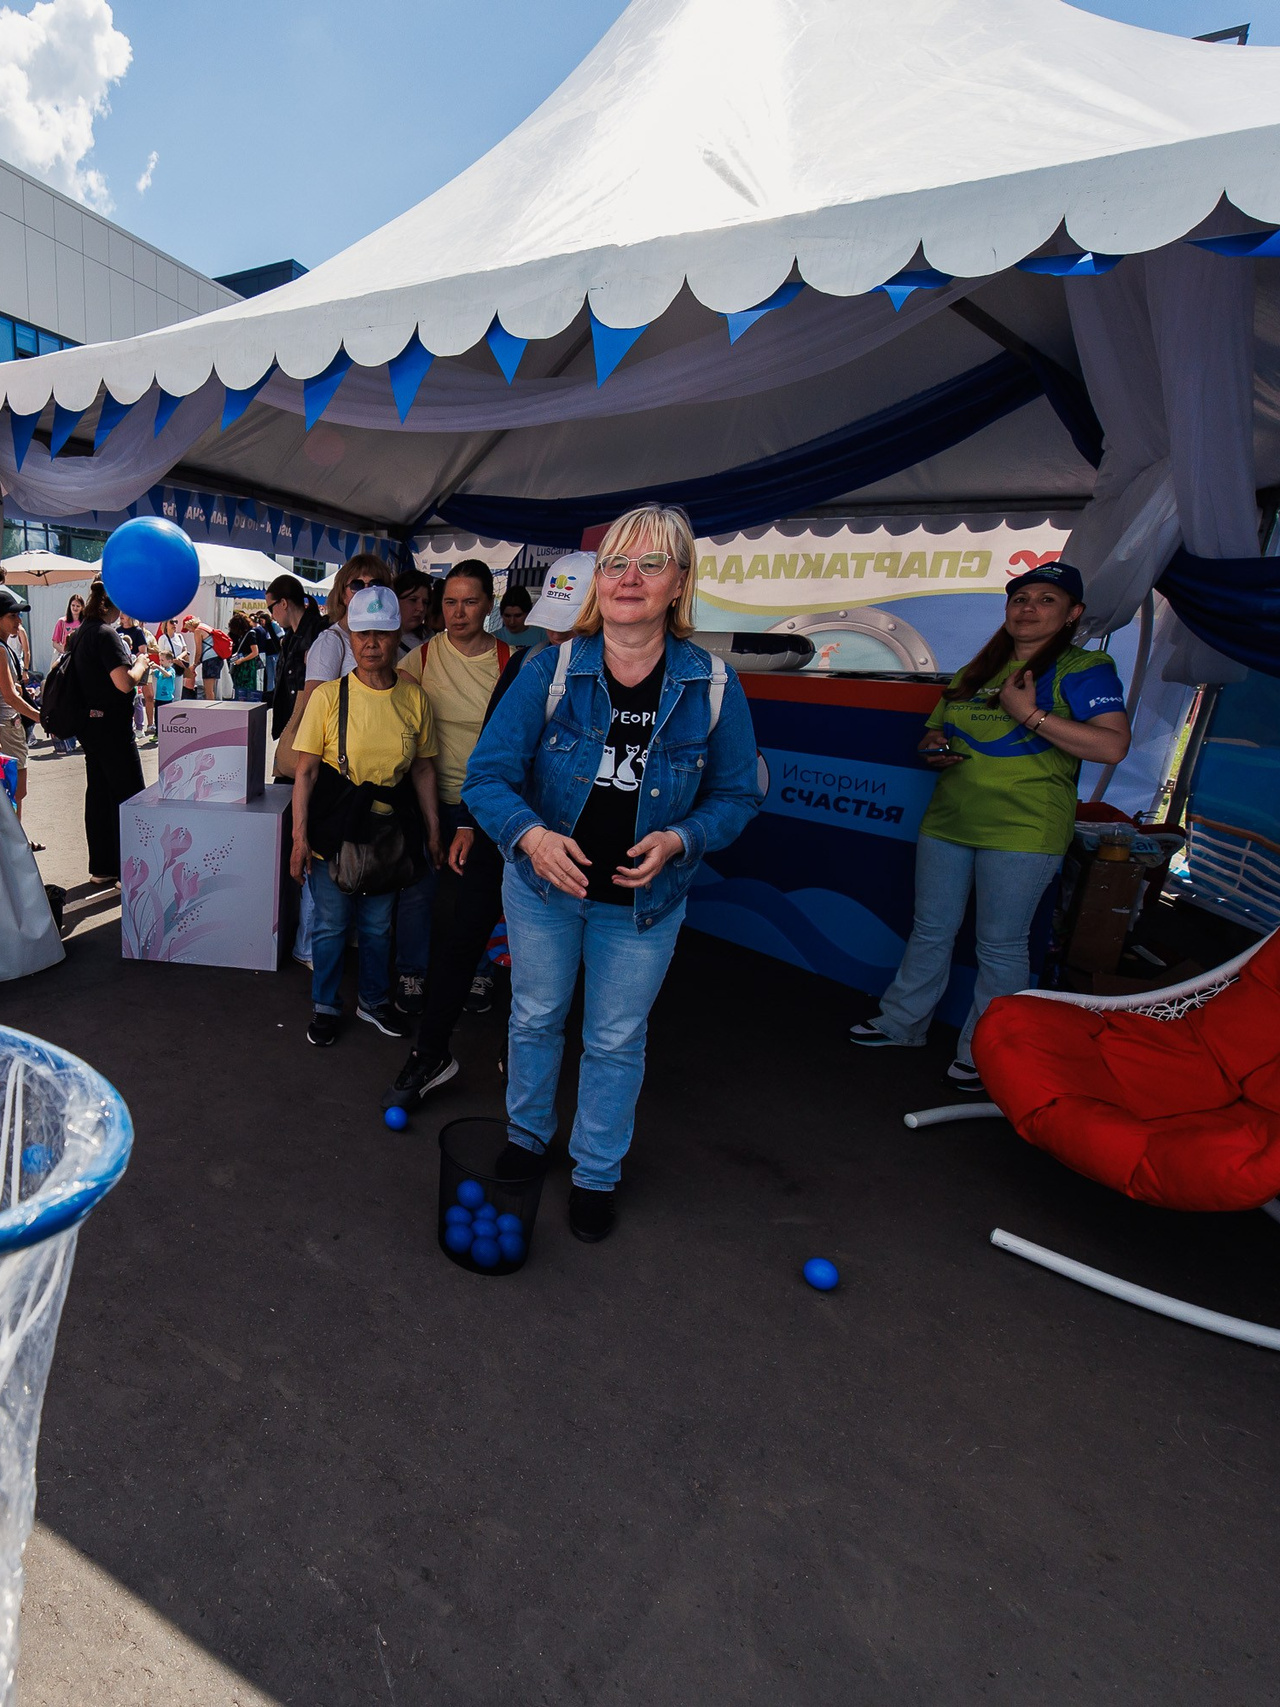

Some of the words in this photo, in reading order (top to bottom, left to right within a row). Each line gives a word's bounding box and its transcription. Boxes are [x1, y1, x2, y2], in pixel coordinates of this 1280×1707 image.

[547, 590, 571, 599] ФТРК
[611, 708, 657, 727] PEOPL
[971, 713, 1012, 722] волне
[161, 722, 198, 734] Luscan
[783, 762, 886, 795] Истории
[780, 786, 905, 824] СЧАСТЬЯ
